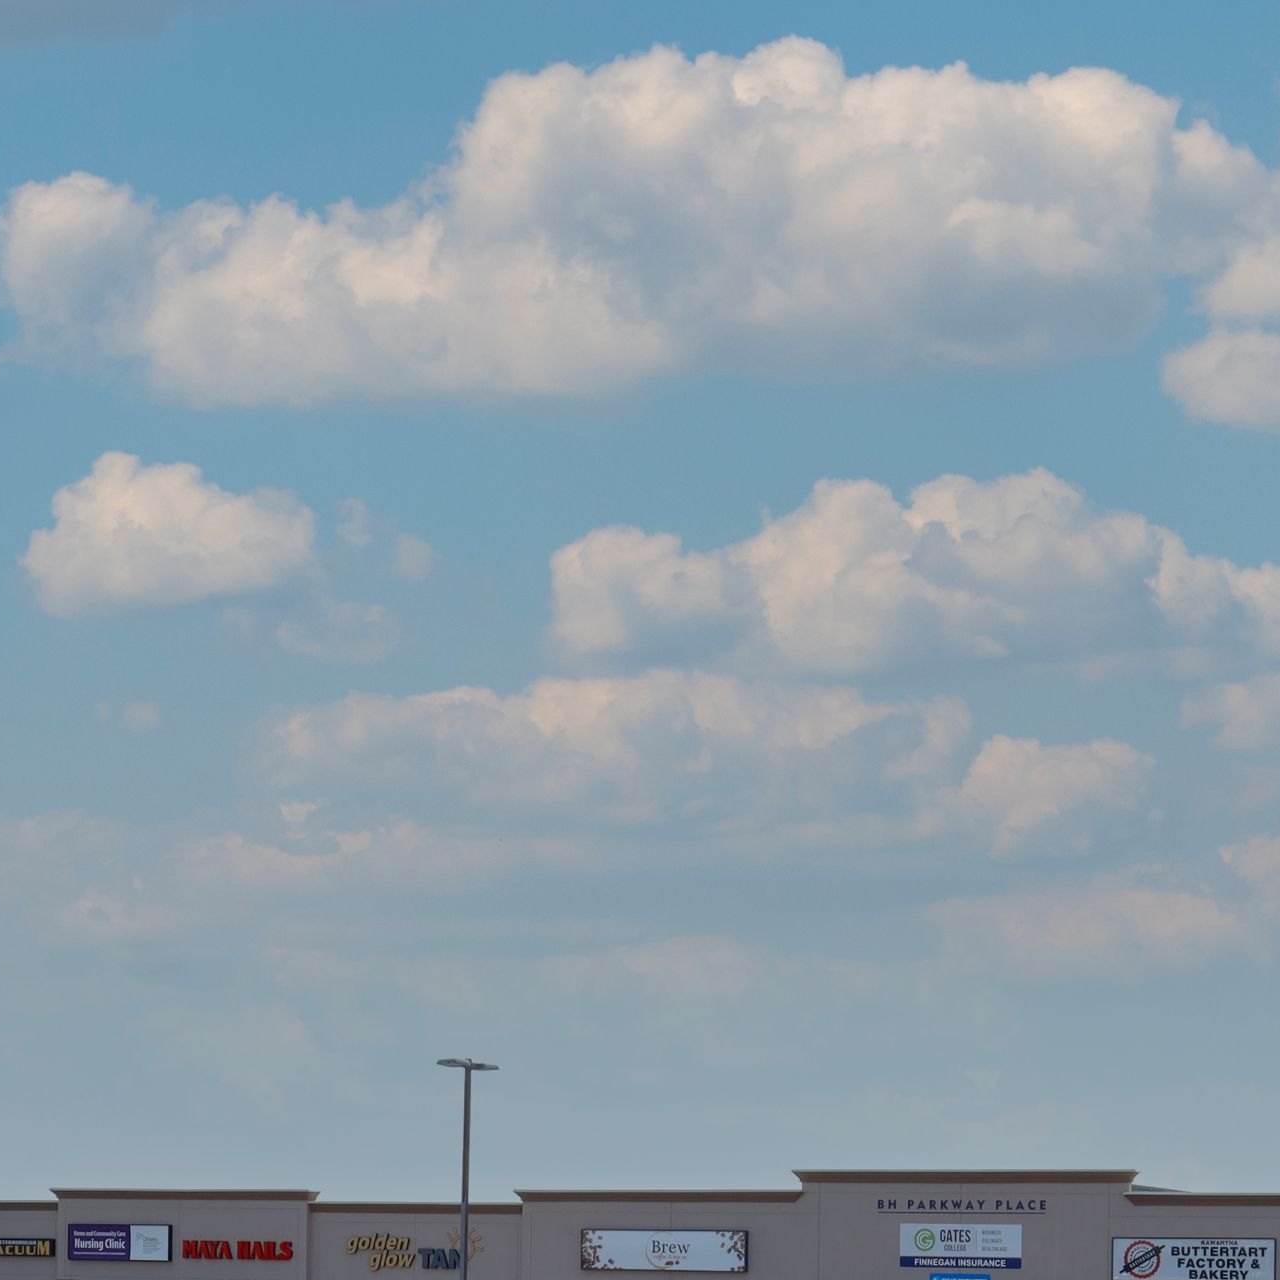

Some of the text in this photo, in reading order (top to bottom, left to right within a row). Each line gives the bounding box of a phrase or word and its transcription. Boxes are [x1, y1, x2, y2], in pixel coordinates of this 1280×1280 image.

[877, 1199, 1047, 1211] BH PARKWAY PLACE
[940, 1229, 971, 1243] GATES
[74, 1238, 126, 1251] Nursing Clinic
[347, 1232, 410, 1254] golden
[651, 1239, 691, 1254] Brew
[182, 1239, 233, 1260] MAYA
[236, 1240, 294, 1261] NAILS
[1170, 1246, 1268, 1257] BUTTERTART
[370, 1248, 461, 1272] glow TAN
[914, 1258, 1007, 1268] FINNEGAN INSURANCE
[1177, 1258, 1261, 1269] FACTORY &
[1189, 1269, 1249, 1280] BAKERY
